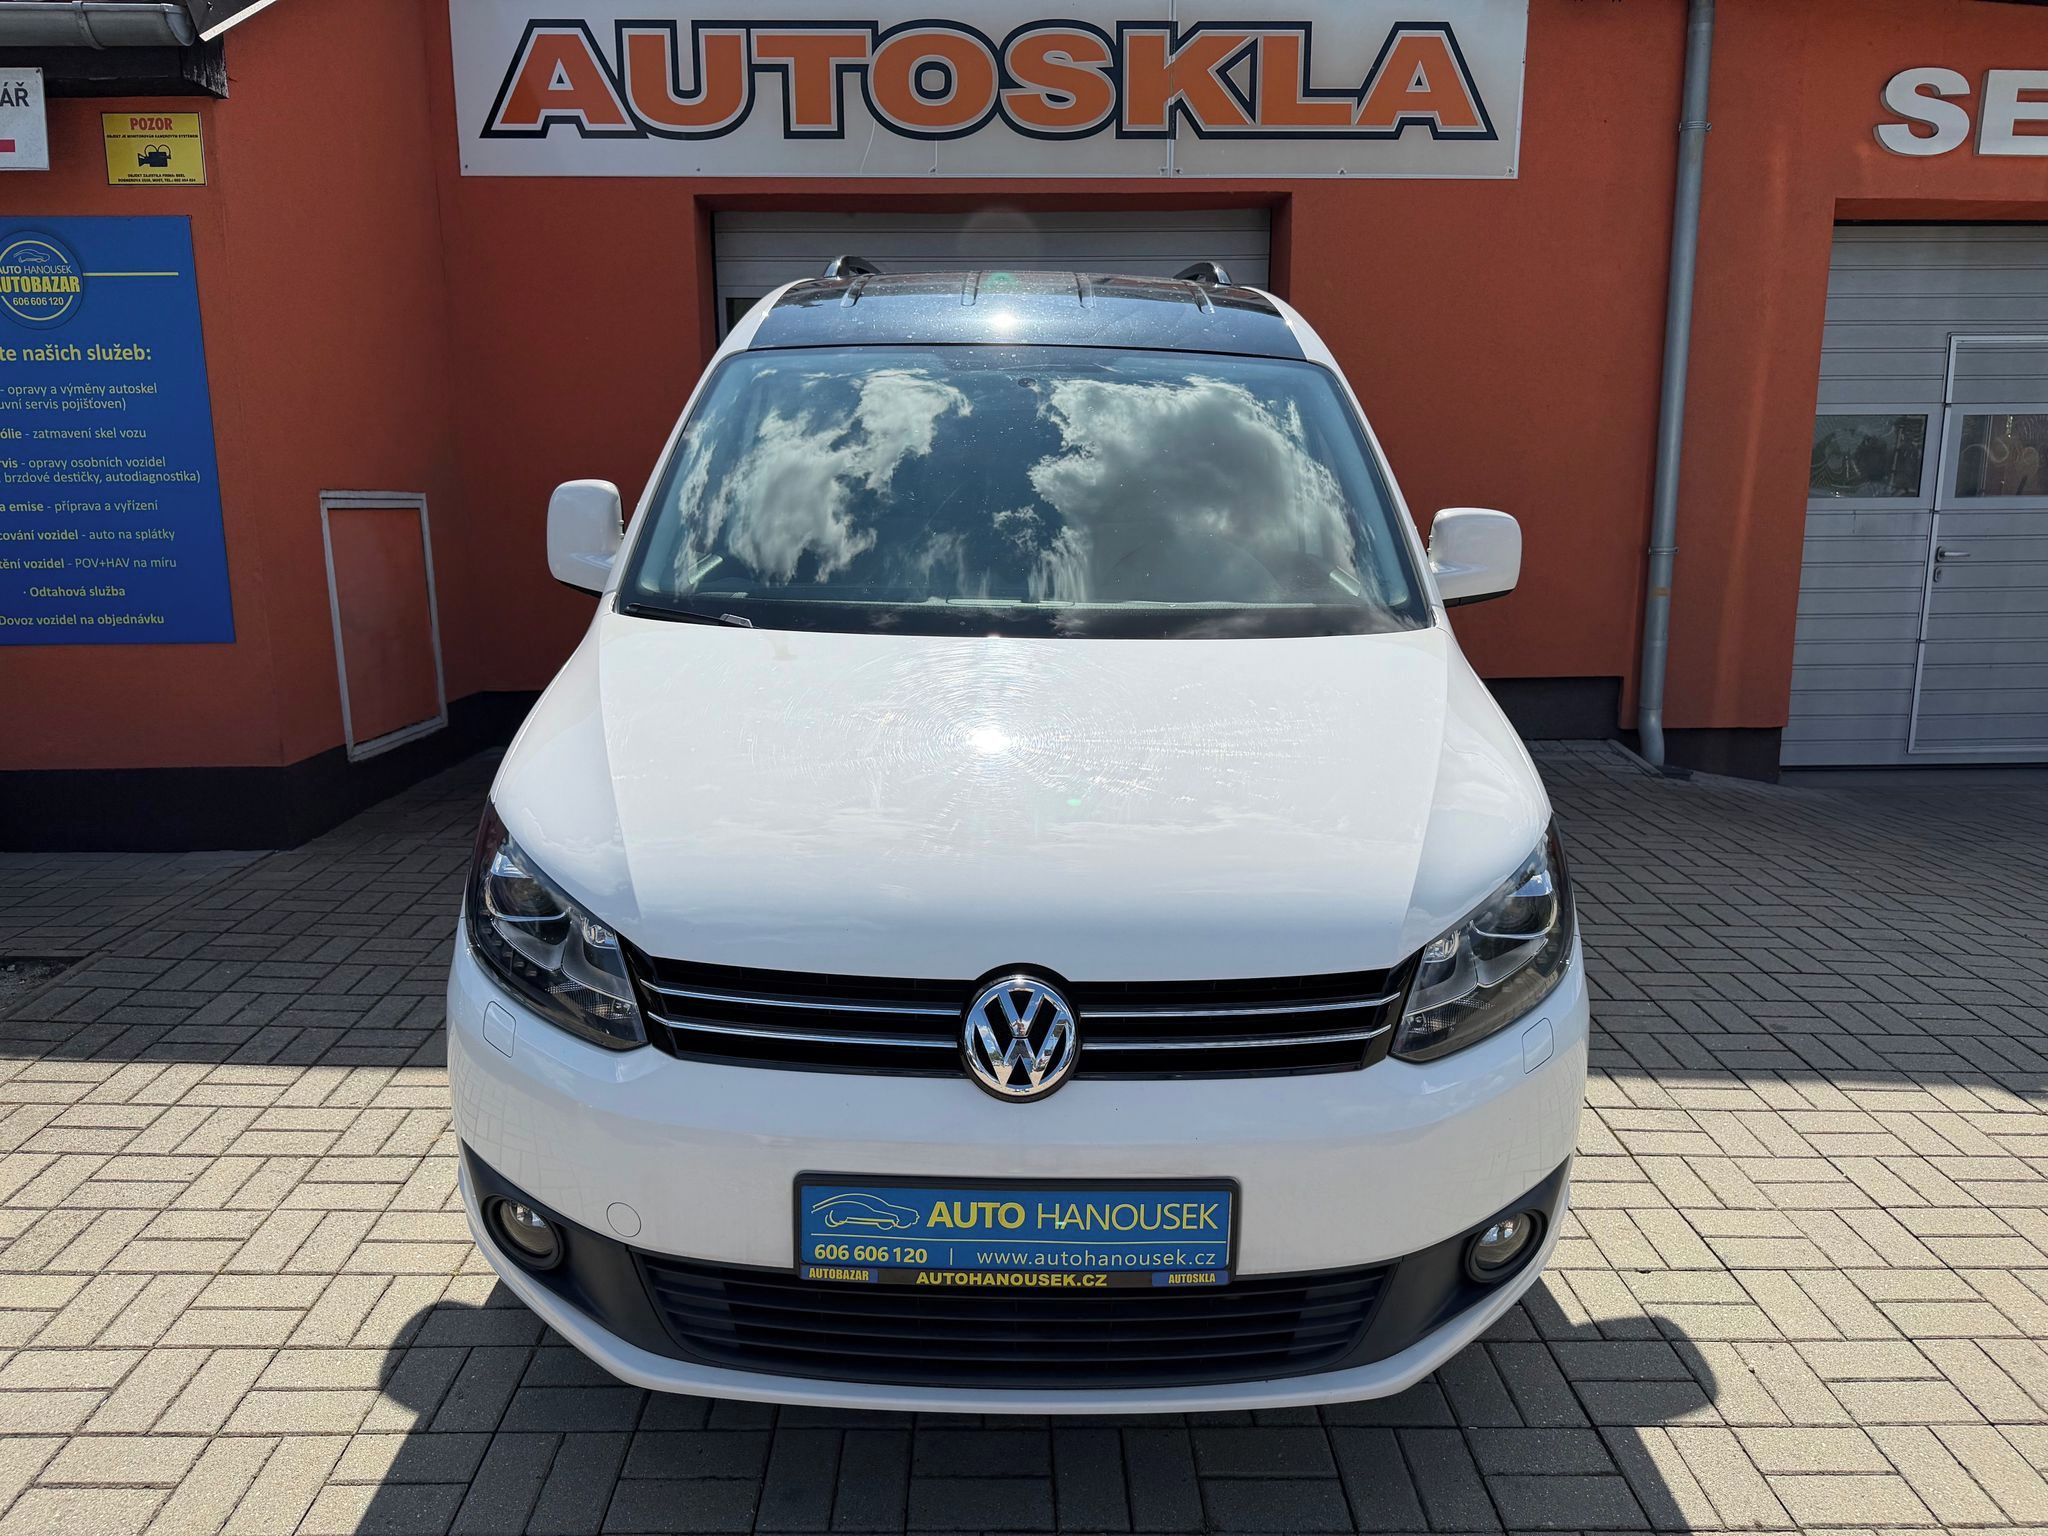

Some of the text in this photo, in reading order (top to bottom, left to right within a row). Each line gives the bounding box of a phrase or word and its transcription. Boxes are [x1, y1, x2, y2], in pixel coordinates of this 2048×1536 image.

[479, 18, 1499, 141] AUTOSKLA
[0, 81, 30, 107] ÁŘ
[1872, 66, 2048, 158] SE
[129, 117, 173, 131] POZOR
[24, 264, 73, 274] HANOUSEK
[0, 276, 80, 293] UTOBAZAR
[13, 297, 64, 306] 606 606 120
[23, 344, 81, 361] našich
[87, 343, 152, 361] služeb:
[7, 386, 47, 397] opravy
[50, 386, 57, 395] a
[60, 384, 106, 397] výměny
[109, 382, 158, 395] autoskel
[25, 398, 59, 410] servis
[62, 397, 126, 412] pojišťoven)
[33, 428, 91, 439] zatmavení
[94, 426, 117, 439] skel
[120, 429, 147, 438] vozu
[0, 457, 18, 468] vis
[28, 459, 67, 470] opravy
[71, 456, 123, 468] osobních
[125, 456, 166, 467] vozidel
[4, 470, 201, 484] brzdové destičky, autodiagnostika)
[9, 501, 44, 512] emise
[54, 501, 101, 513] příprava
[105, 503, 111, 511] a
[114, 500, 158, 513] vyřízení
[37, 529, 79, 540] vozidel
[89, 531, 115, 540] auto
[118, 532, 132, 540] na
[135, 529, 175, 542] splátky
[23, 557, 65, 569] vozidel
[75, 558, 130, 568] POV+HAV
[133, 559, 147, 568] na
[150, 557, 177, 568] míru
[29, 585, 126, 597] Odtahová služba
[0, 614, 165, 627] Dovoz vozidel na objednávku
[964, 978, 1076, 1096] VW
[926, 1201, 1219, 1231] AUTO HANOUSEK
[814, 1244, 1216, 1266] 606 606 120 www.autohanousek.cz
[808, 1267, 1216, 1287] AUTOBAZAR AUTOHANOUSEK.CZ AUTOSKLA
